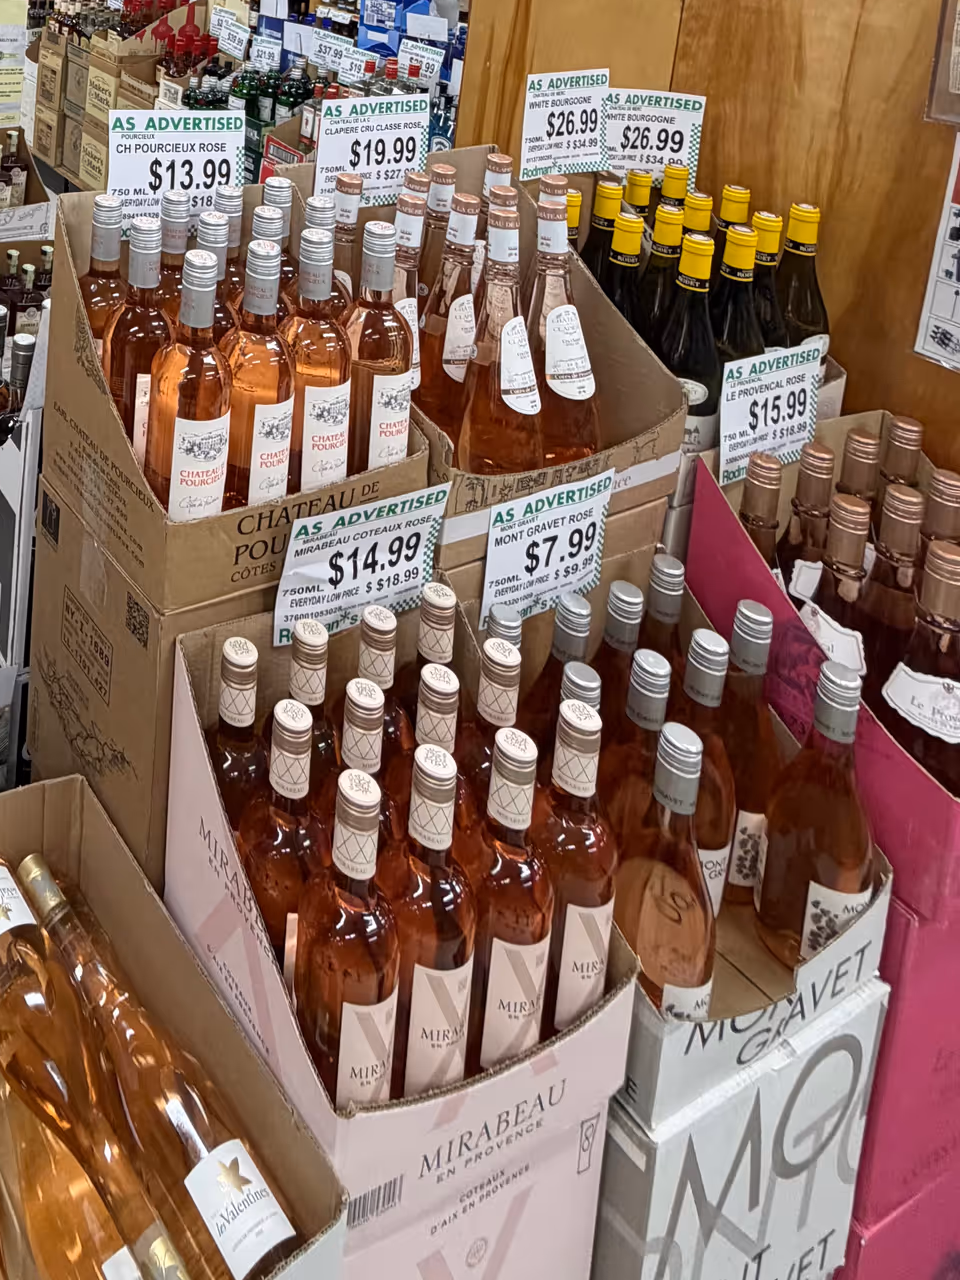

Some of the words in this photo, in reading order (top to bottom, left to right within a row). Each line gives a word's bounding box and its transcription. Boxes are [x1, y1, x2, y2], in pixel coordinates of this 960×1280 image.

[318, 44, 343, 59] $37.99
[89, 79, 111, 97] Maker's
[528, 80, 542, 91] AS
[547, 74, 607, 89] ADVERTISED
[324, 105, 342, 117] AS
[349, 100, 427, 116] ADVERTISED
[529, 100, 549, 109] WHITE
[551, 96, 592, 107] BOURGOGNE
[606, 93, 620, 104] AS
[625, 94, 702, 111] ADVERTISED
[112, 117, 135, 130] AS
[145, 117, 243, 130] ADVERTISED
[546, 108, 598, 140] $26.99
[627, 114, 676, 124] BOURGOGNE
[325, 127, 358, 135] CLAPIERE
[621, 125, 684, 153] $26.99
[116, 144, 131, 154] CH
[135, 144, 196, 153] POURCIEUX
[199, 143, 226, 152] ROSE
[349, 136, 416, 170] $19.99
[566, 141, 570, 149] $
[573, 138, 598, 150] $34.99
[148, 157, 231, 195] $13.99
[376, 170, 380, 179] $
[147, 198, 159, 206] LOW
[726, 366, 742, 381] AS
[749, 348, 820, 377] ADVERTISED
[726, 392, 736, 402] LE
[738, 380, 783, 399] PROVENCAL
[786, 373, 806, 386] ROSE
[737, 377, 762, 387] PROVENCAL
[749, 388, 807, 434] $15.99
[723, 434, 736, 442] 750
[739, 430, 750, 439] ML
[772, 429, 777, 439] $
[779, 422, 807, 439] $18.99
[70, 418, 99, 454] CHATEAU
[100, 448, 109, 467] DE
[110, 459, 155, 513] POURCIEUX
[237, 488, 355, 535] CHATEAU
[361, 481, 380, 497] DE
[492, 508, 514, 526] AS
[522, 476, 612, 517] ADVERTISED
[294, 522, 323, 539] AS
[332, 489, 447, 530] ADVERTISED
[500, 523, 516, 532] MONT
[518, 516, 539, 528] GRAVET
[294, 537, 350, 558] MIRABEAU
[352, 523, 402, 541] COTEAUX
[405, 515, 432, 528] ROSE
[302, 531, 338, 545] MIRABEAU
[494, 531, 525, 547] MONT
[526, 517, 566, 537] GRAVET
[568, 507, 594, 525] ROSE
[328, 532, 421, 589] $14.99
[524, 522, 597, 576] $7.99
[231, 561, 276, 580] CÔTES
[488, 574, 522, 589] 750ML
[494, 582, 522, 598] EVERYDAY
[522, 579, 534, 591] LOW
[534, 574, 550, 586] PRICE
[554, 570, 560, 580] $
[563, 554, 594, 578] $9.99
[282, 585, 325, 597] 750ML
[290, 595, 326, 608] EVERYDAY
[326, 591, 341, 603] LOW
[342, 586, 360, 598] PRICE
[366, 582, 372, 594] $
[376, 567, 419, 592] $18.99
[910, 695, 924, 709] Le
[417, 1078, 568, 1180] MIRABEAU
[436, 1166, 457, 1184] EN
[464, 1118, 544, 1168] PROVENCE
[459, 1169, 506, 1204] COTEAUX
[219, 1187, 270, 1227] Valentines
[430, 1211, 458, 1236] D'AIX
[462, 1200, 475, 1215] EN
[479, 1163, 530, 1203] PROVENCE
